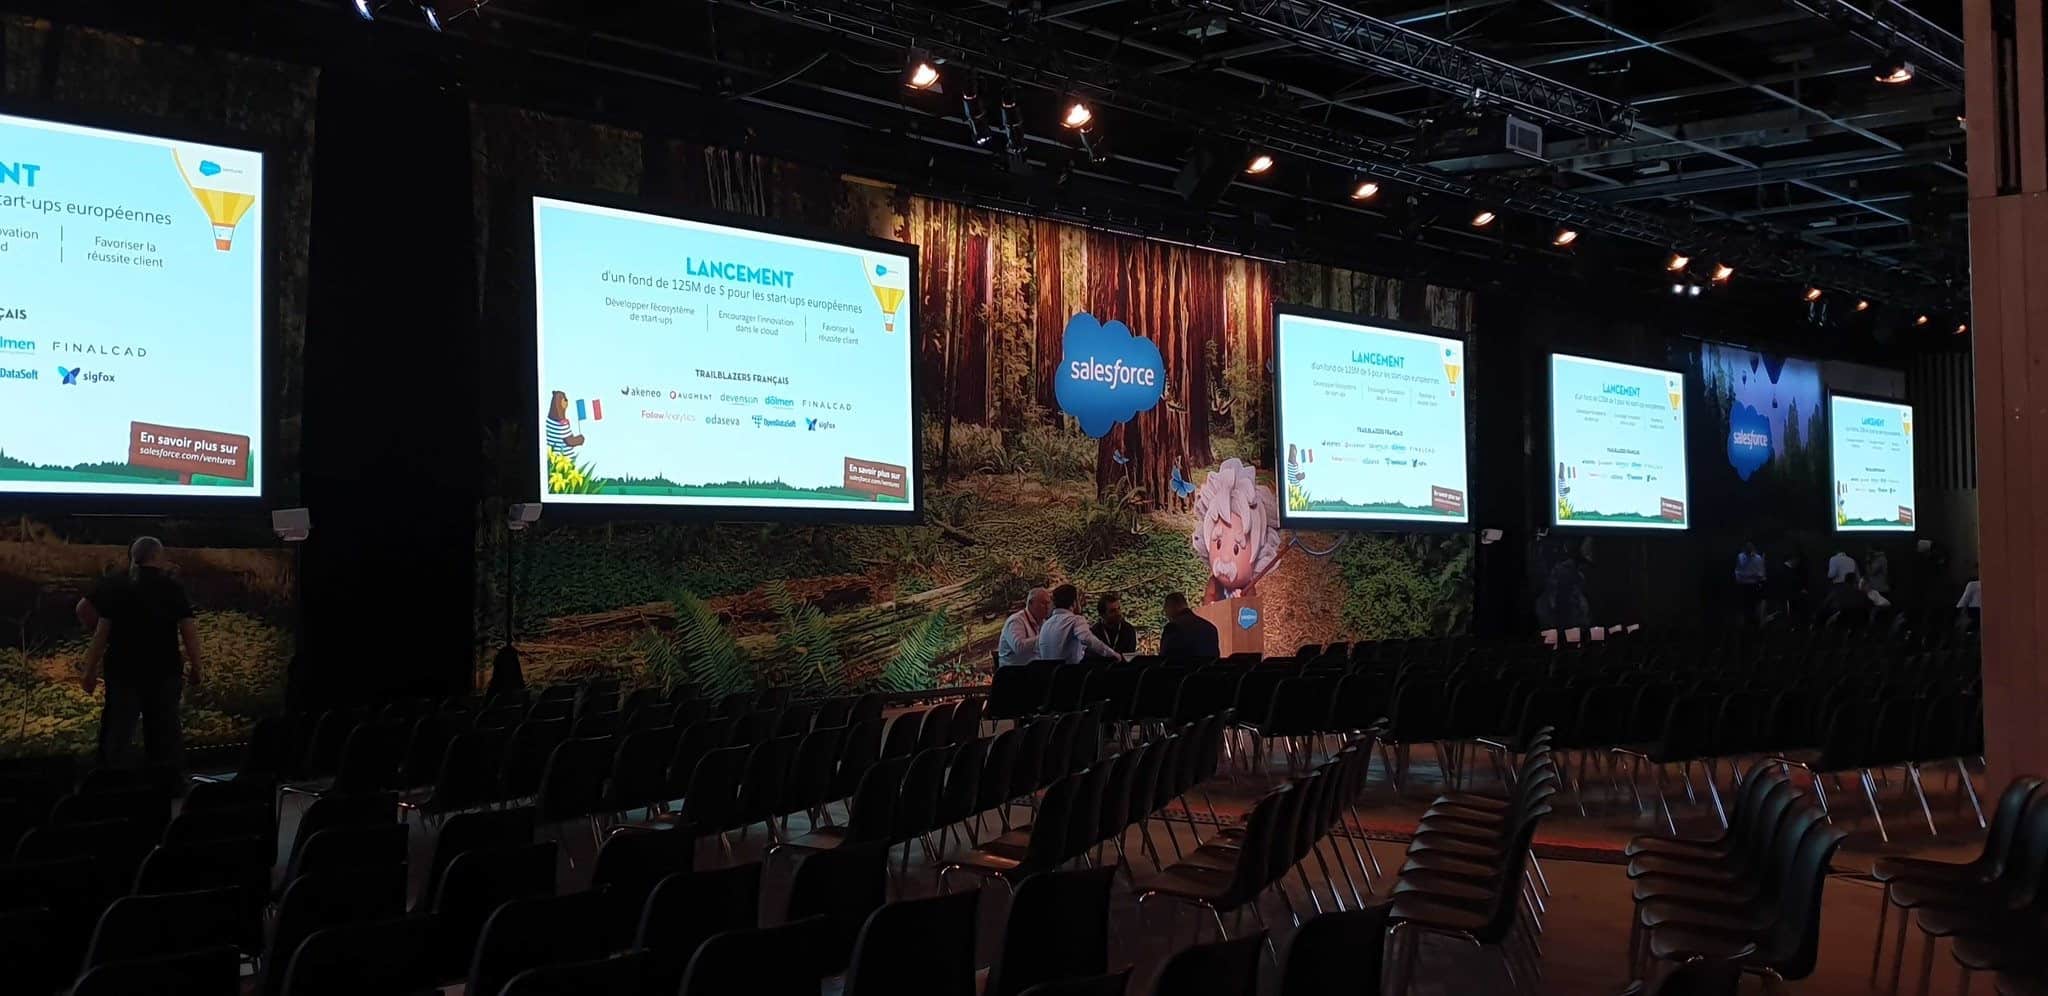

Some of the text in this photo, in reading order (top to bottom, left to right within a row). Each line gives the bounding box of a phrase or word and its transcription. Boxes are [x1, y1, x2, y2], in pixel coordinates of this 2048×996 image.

[66, 203, 172, 226] européennes
[95, 236, 157, 252] Favoriser la
[87, 249, 164, 268] réussite client
[686, 256, 794, 288] LANCEMENT
[601, 270, 625, 284] d'un
[628, 273, 653, 287] fond
[656, 277, 669, 289] de
[672, 279, 701, 293] 125M
[704, 284, 716, 295] de
[727, 288, 750, 300] pour
[752, 288, 765, 301] les
[767, 292, 805, 306] start-ups
[807, 300, 863, 314] européennes
[52, 341, 148, 358] FINALCAD
[1351, 350, 1405, 369] LANCEMENT
[83, 371, 116, 383] sigfox
[695, 368, 789, 386] TRAILBLAZERS FRANÇAIS
[1070, 356, 1155, 389] salesforce
[631, 387, 661, 398] akeneo
[802, 399, 853, 411] FINALCAD
[140, 431, 239, 454] En savoir plus sur
[1733, 428, 1768, 450] salesforce
[139, 446, 237, 466] salesforce.com/ventures
